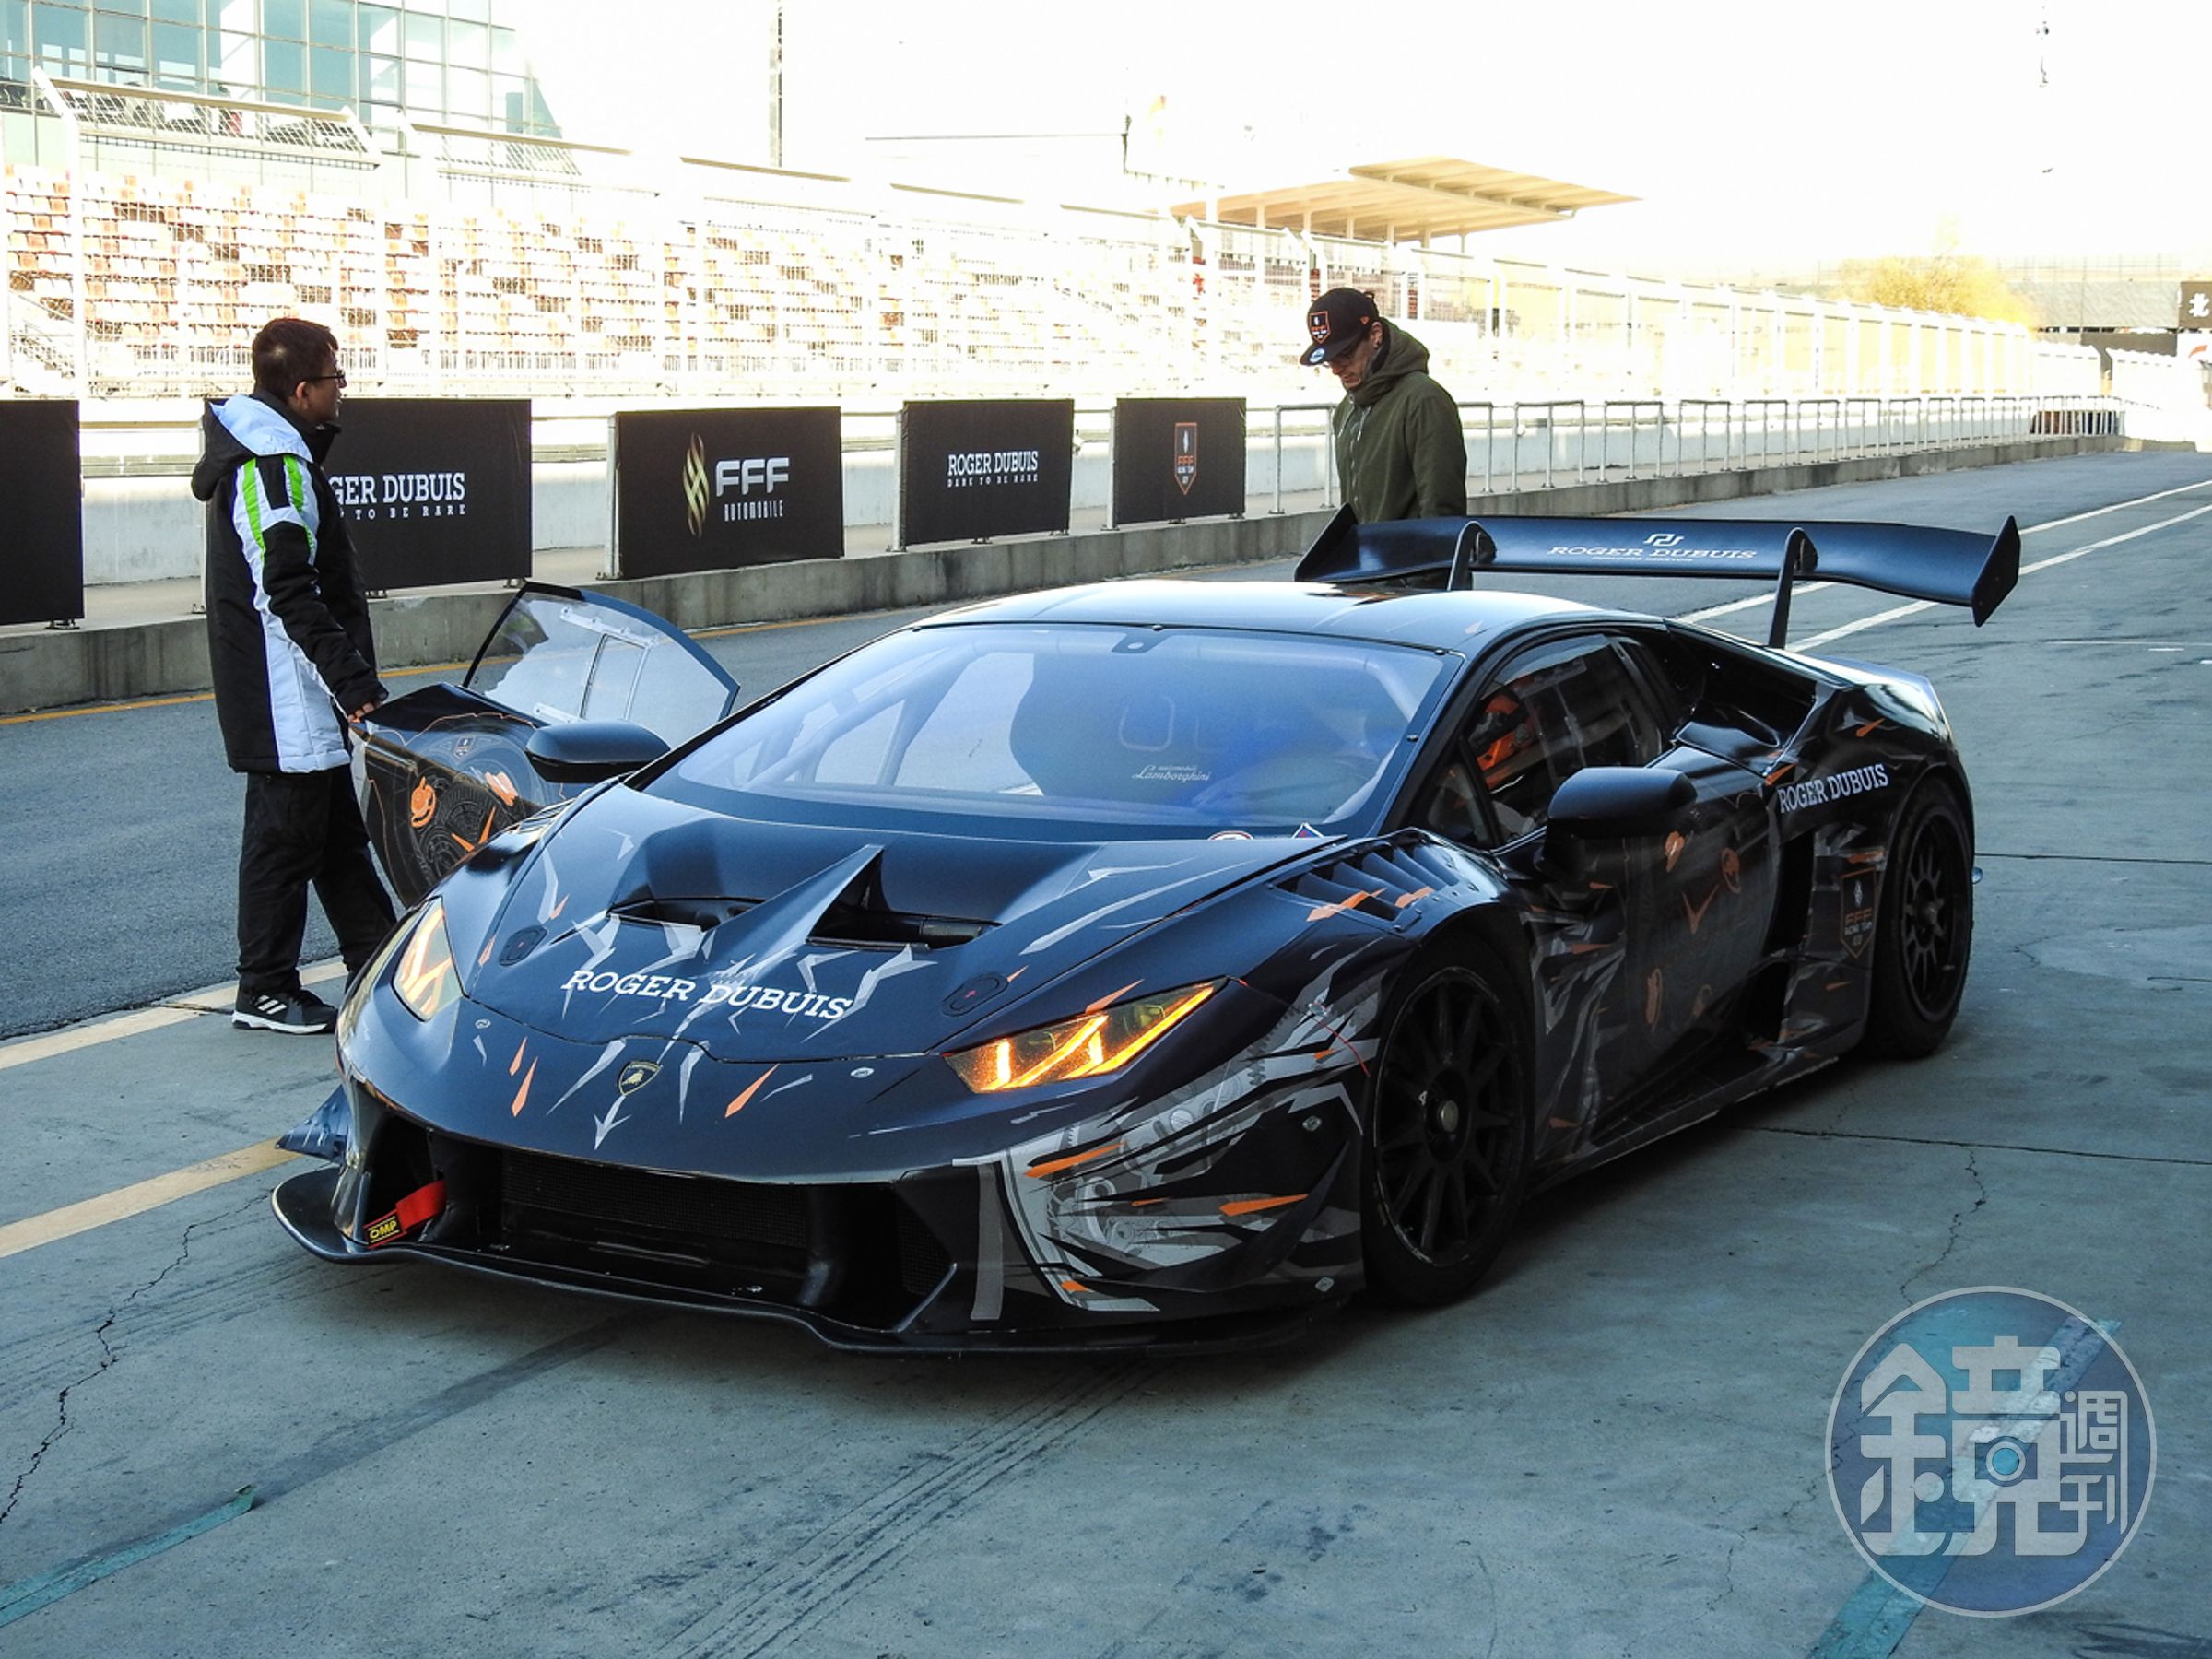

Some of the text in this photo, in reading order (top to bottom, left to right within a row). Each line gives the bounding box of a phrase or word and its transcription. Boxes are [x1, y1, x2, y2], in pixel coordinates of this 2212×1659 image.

[947, 451, 1039, 476] ROGER DUBUIS
[329, 472, 465, 505] GER DUBUIS
[716, 457, 789, 497] FFF
[355, 509, 376, 520] TO
[390, 507, 408, 518] BE
[422, 504, 465, 517] RARE
[1547, 547, 1644, 557] ROGER
[1649, 548, 1758, 560] DUBUIS
[1131, 765, 1212, 783] Lamborghini
[1777, 764, 1888, 813] ROGER DUBUIS
[560, 971, 853, 1018] ROGER DUBUIS
[370, 1220, 397, 1239] OMP
